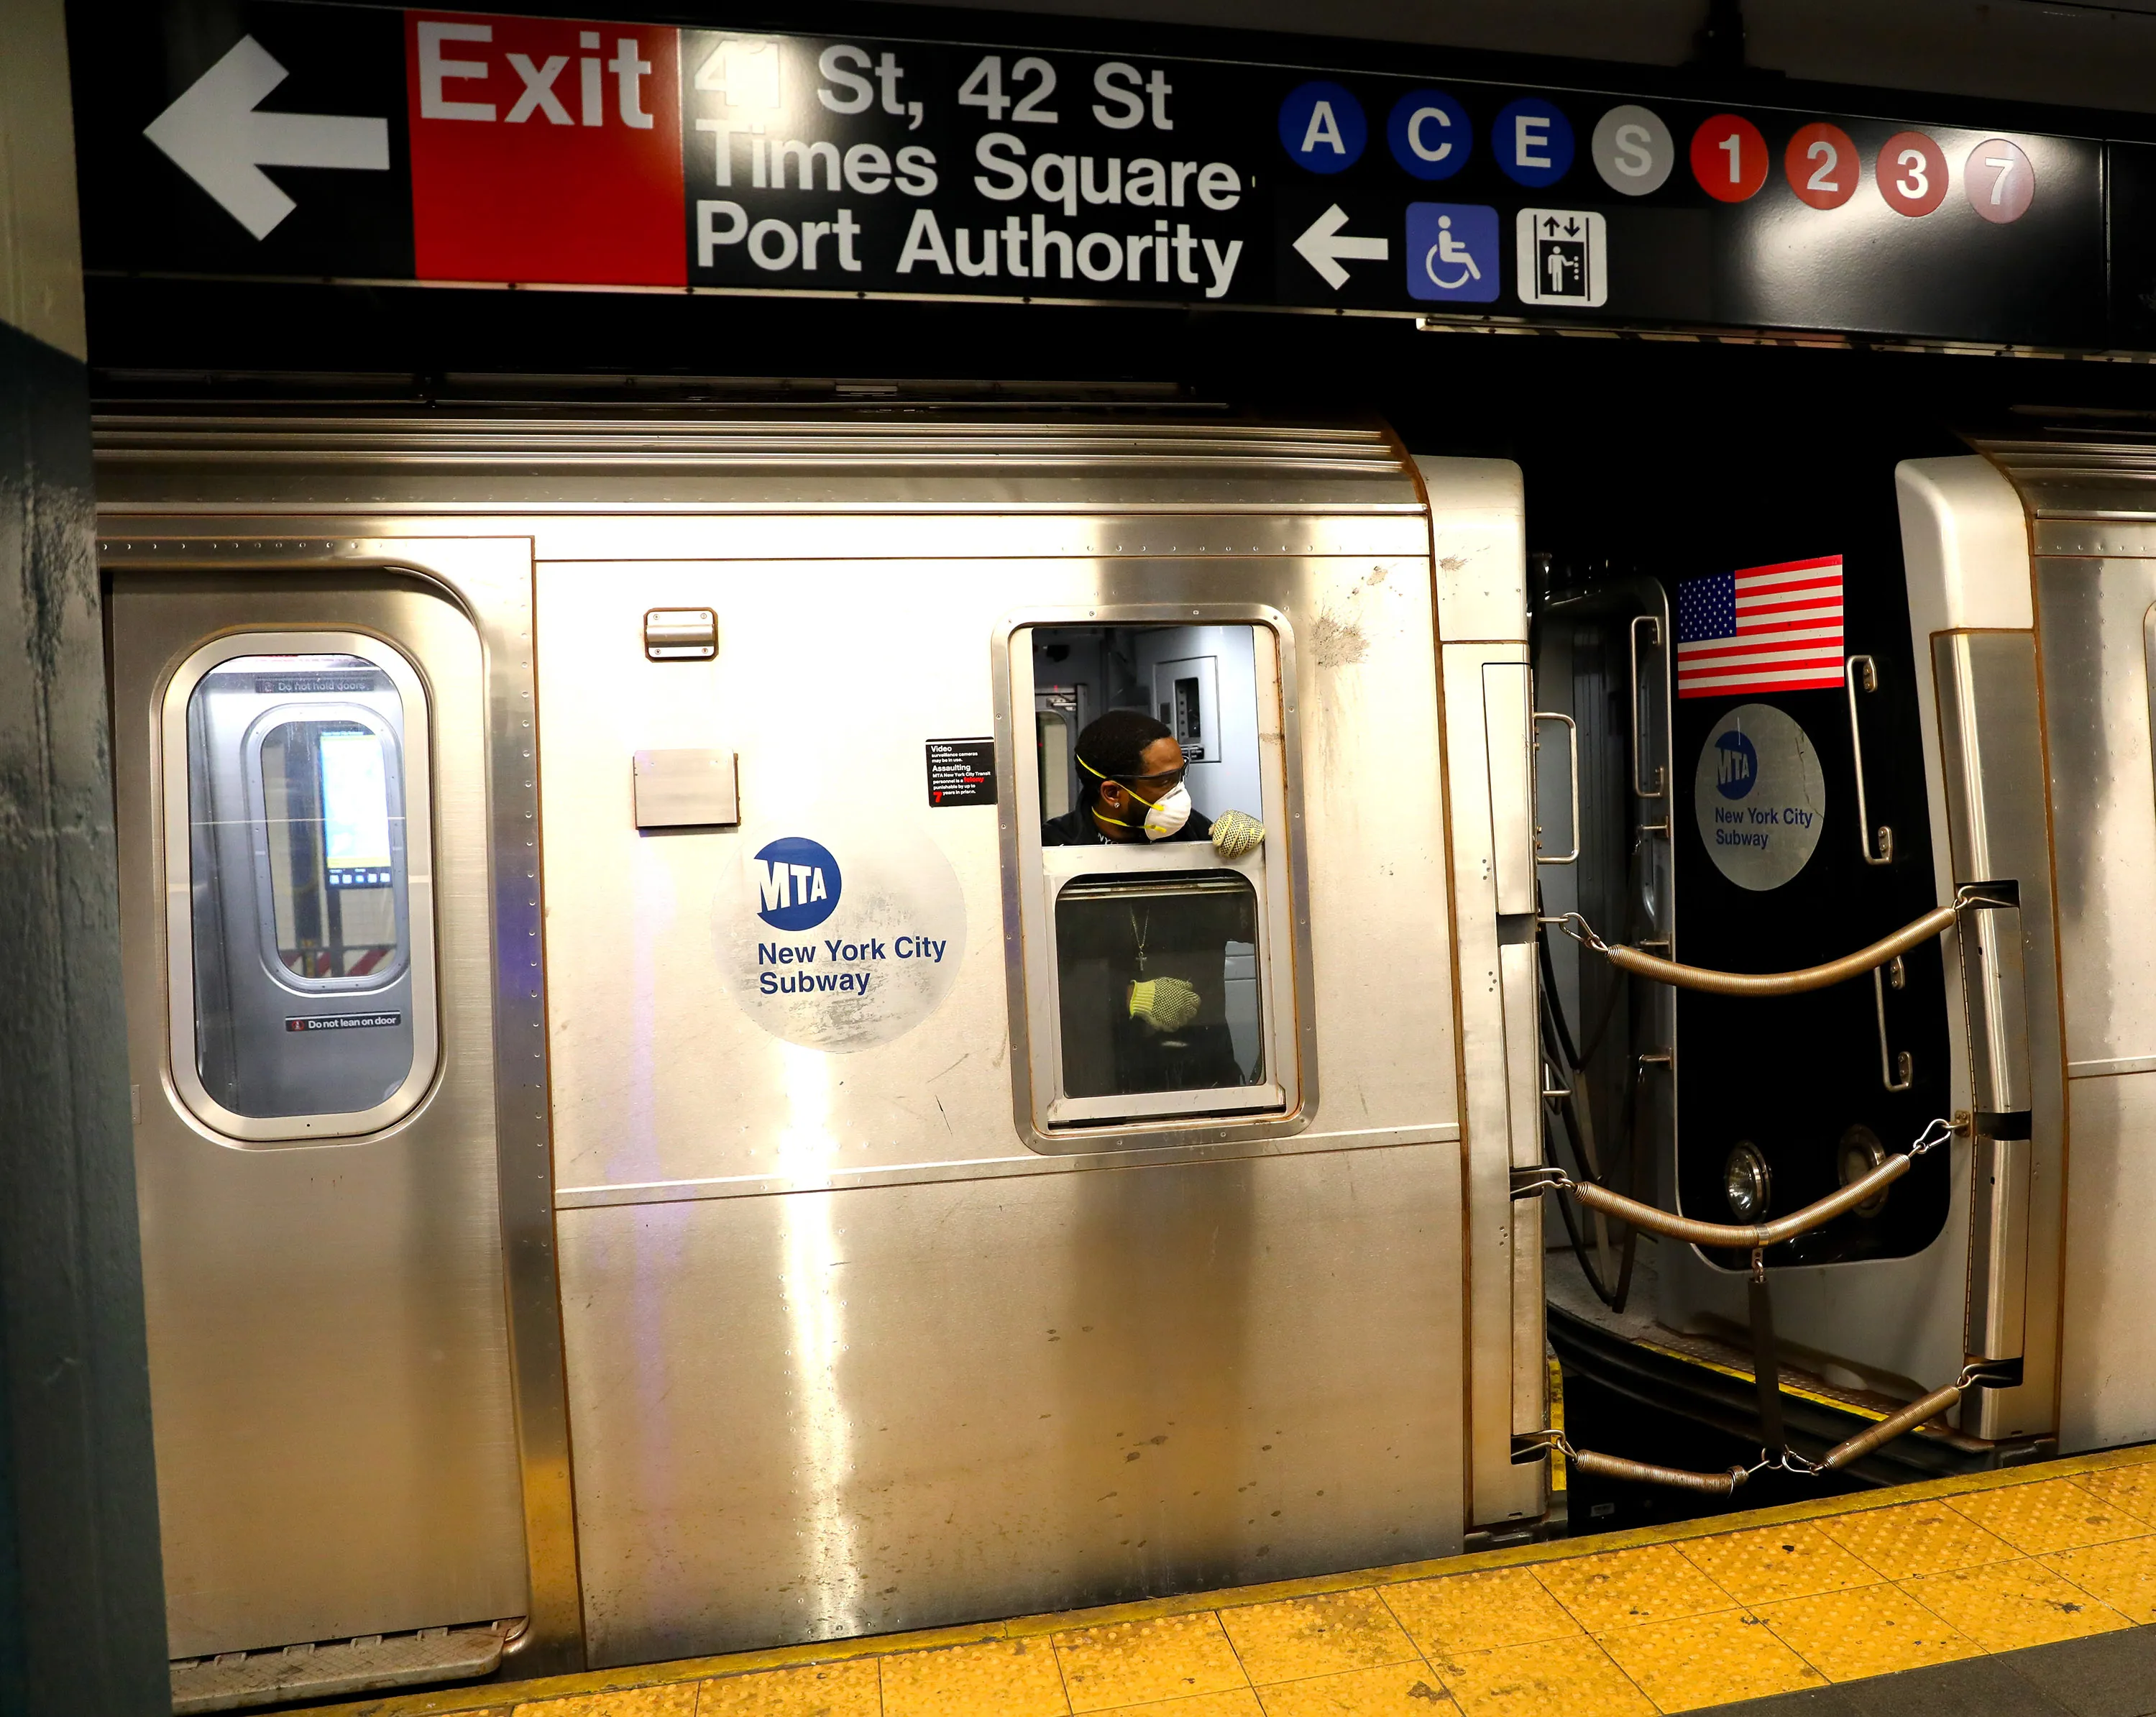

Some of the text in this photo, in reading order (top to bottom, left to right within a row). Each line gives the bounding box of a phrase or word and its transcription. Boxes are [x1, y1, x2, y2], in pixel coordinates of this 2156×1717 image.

[417, 20, 653, 129] Exit
[694, 39, 1173, 131] 41 St, 42 St
[695, 118, 1242, 216] Times Square
[1300, 99, 2014, 207] A C E S 1 2 3 7
[696, 199, 1244, 298] Port Authority
[278, 682, 292, 691] Do
[295, 682, 311, 691] not
[313, 682, 335, 690] hold
[1715, 748, 1751, 785] MTA
[933, 791, 942, 803] 7
[1715, 807, 1813, 828] New York City
[1716, 828, 1769, 850] Subway
[758, 860, 827, 912] MTA
[758, 935, 947, 965] New York City
[759, 969, 871, 996] Subway
[308, 1020, 322, 1029] Do
[341, 1018, 360, 1027] lean
